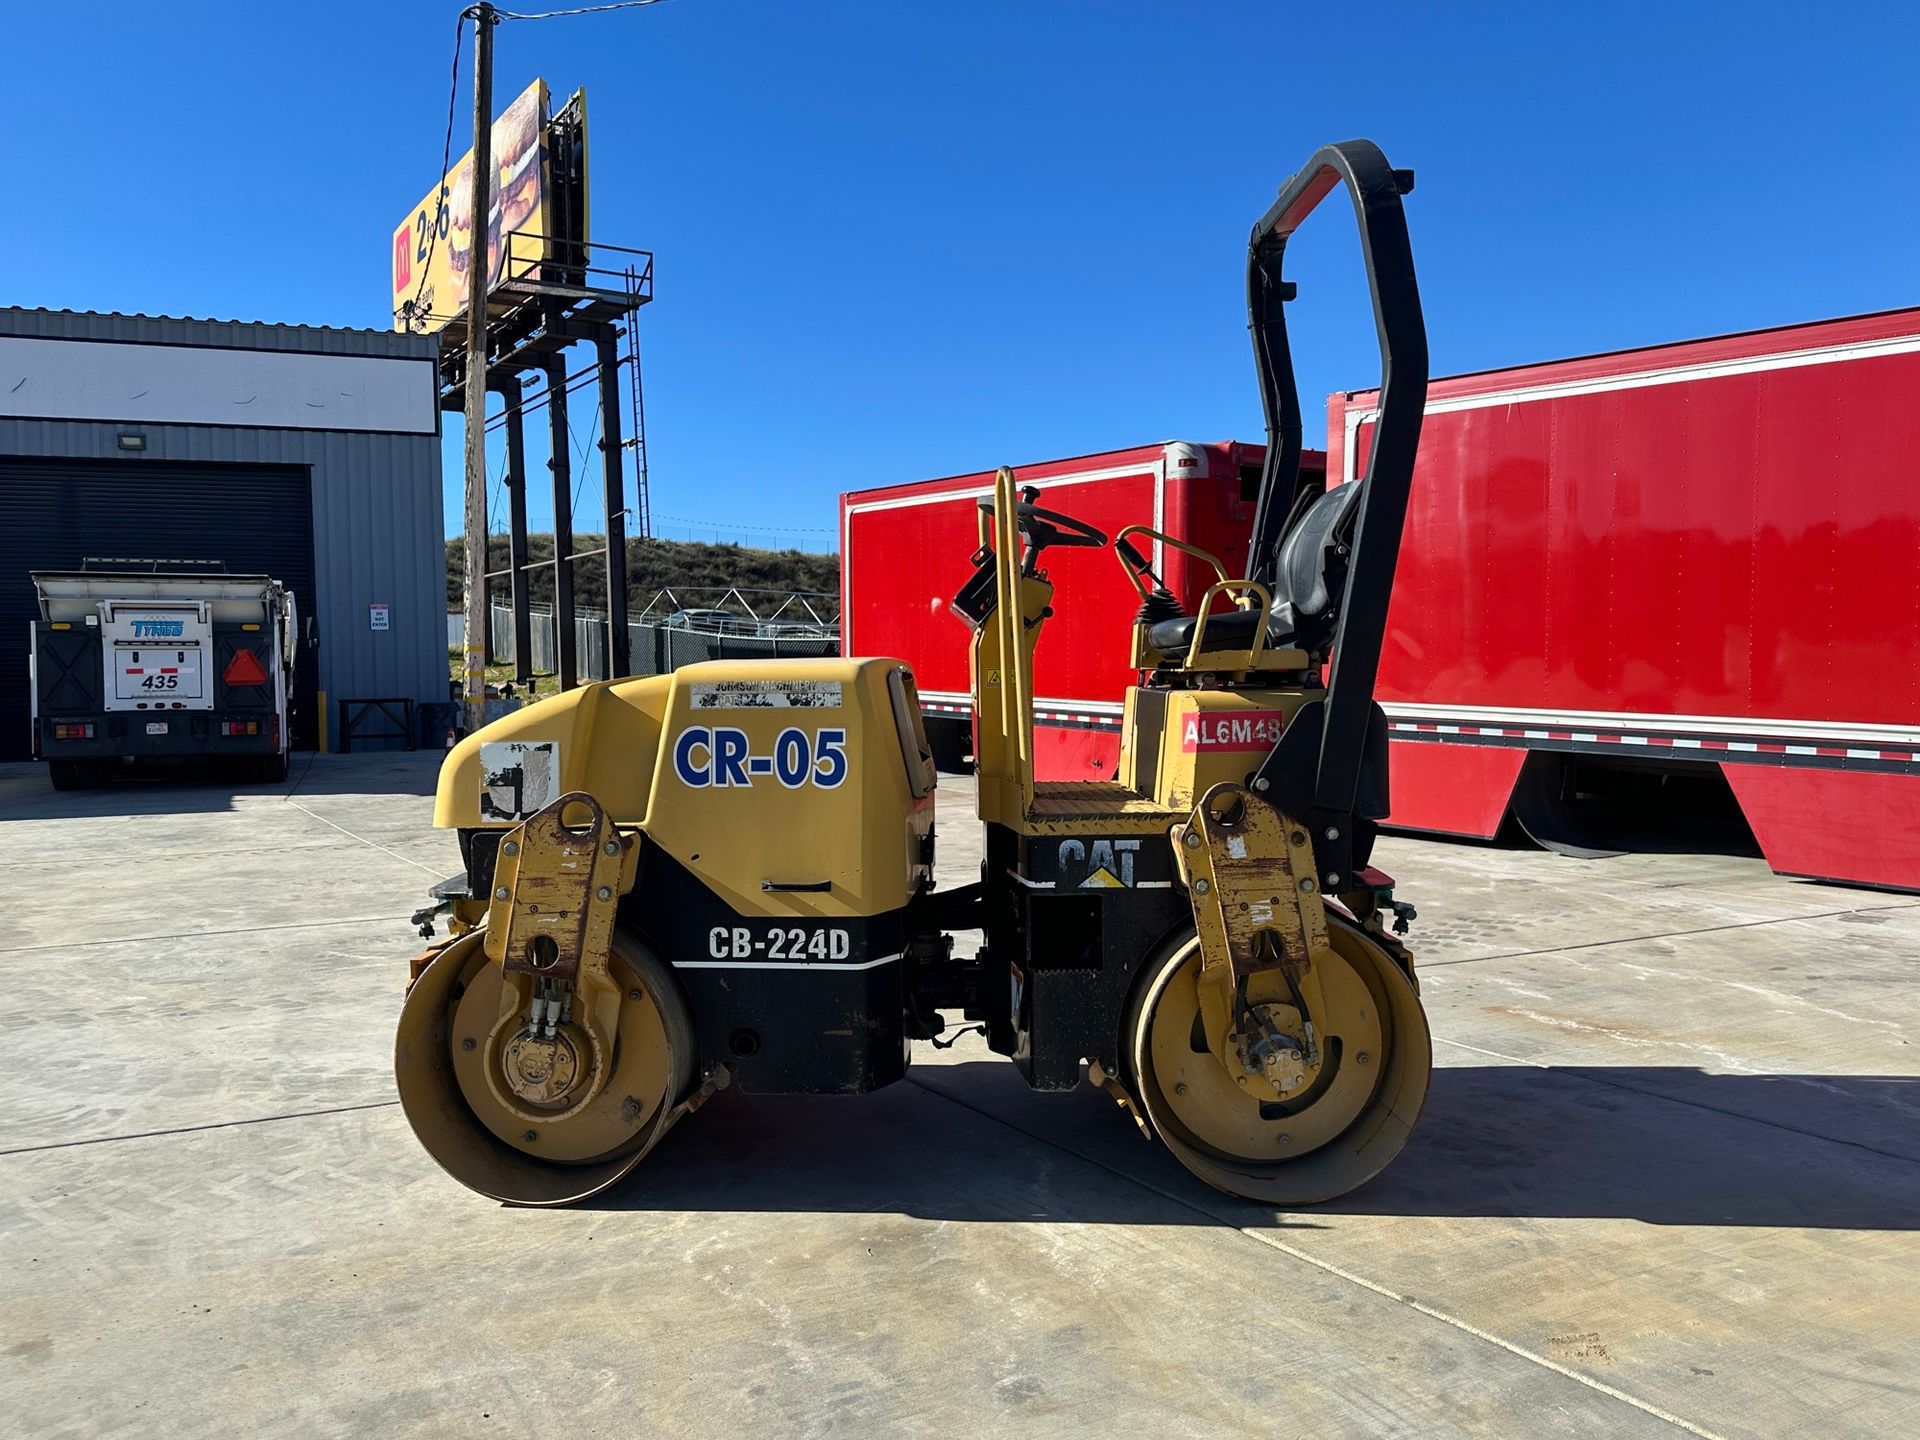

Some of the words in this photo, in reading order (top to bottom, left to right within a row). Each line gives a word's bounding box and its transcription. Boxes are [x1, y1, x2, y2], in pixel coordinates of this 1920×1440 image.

[417, 210, 427, 264] 2
[142, 675, 178, 689] 435
[673, 726, 848, 789] CR-05
[709, 927, 850, 959] CB-224D
